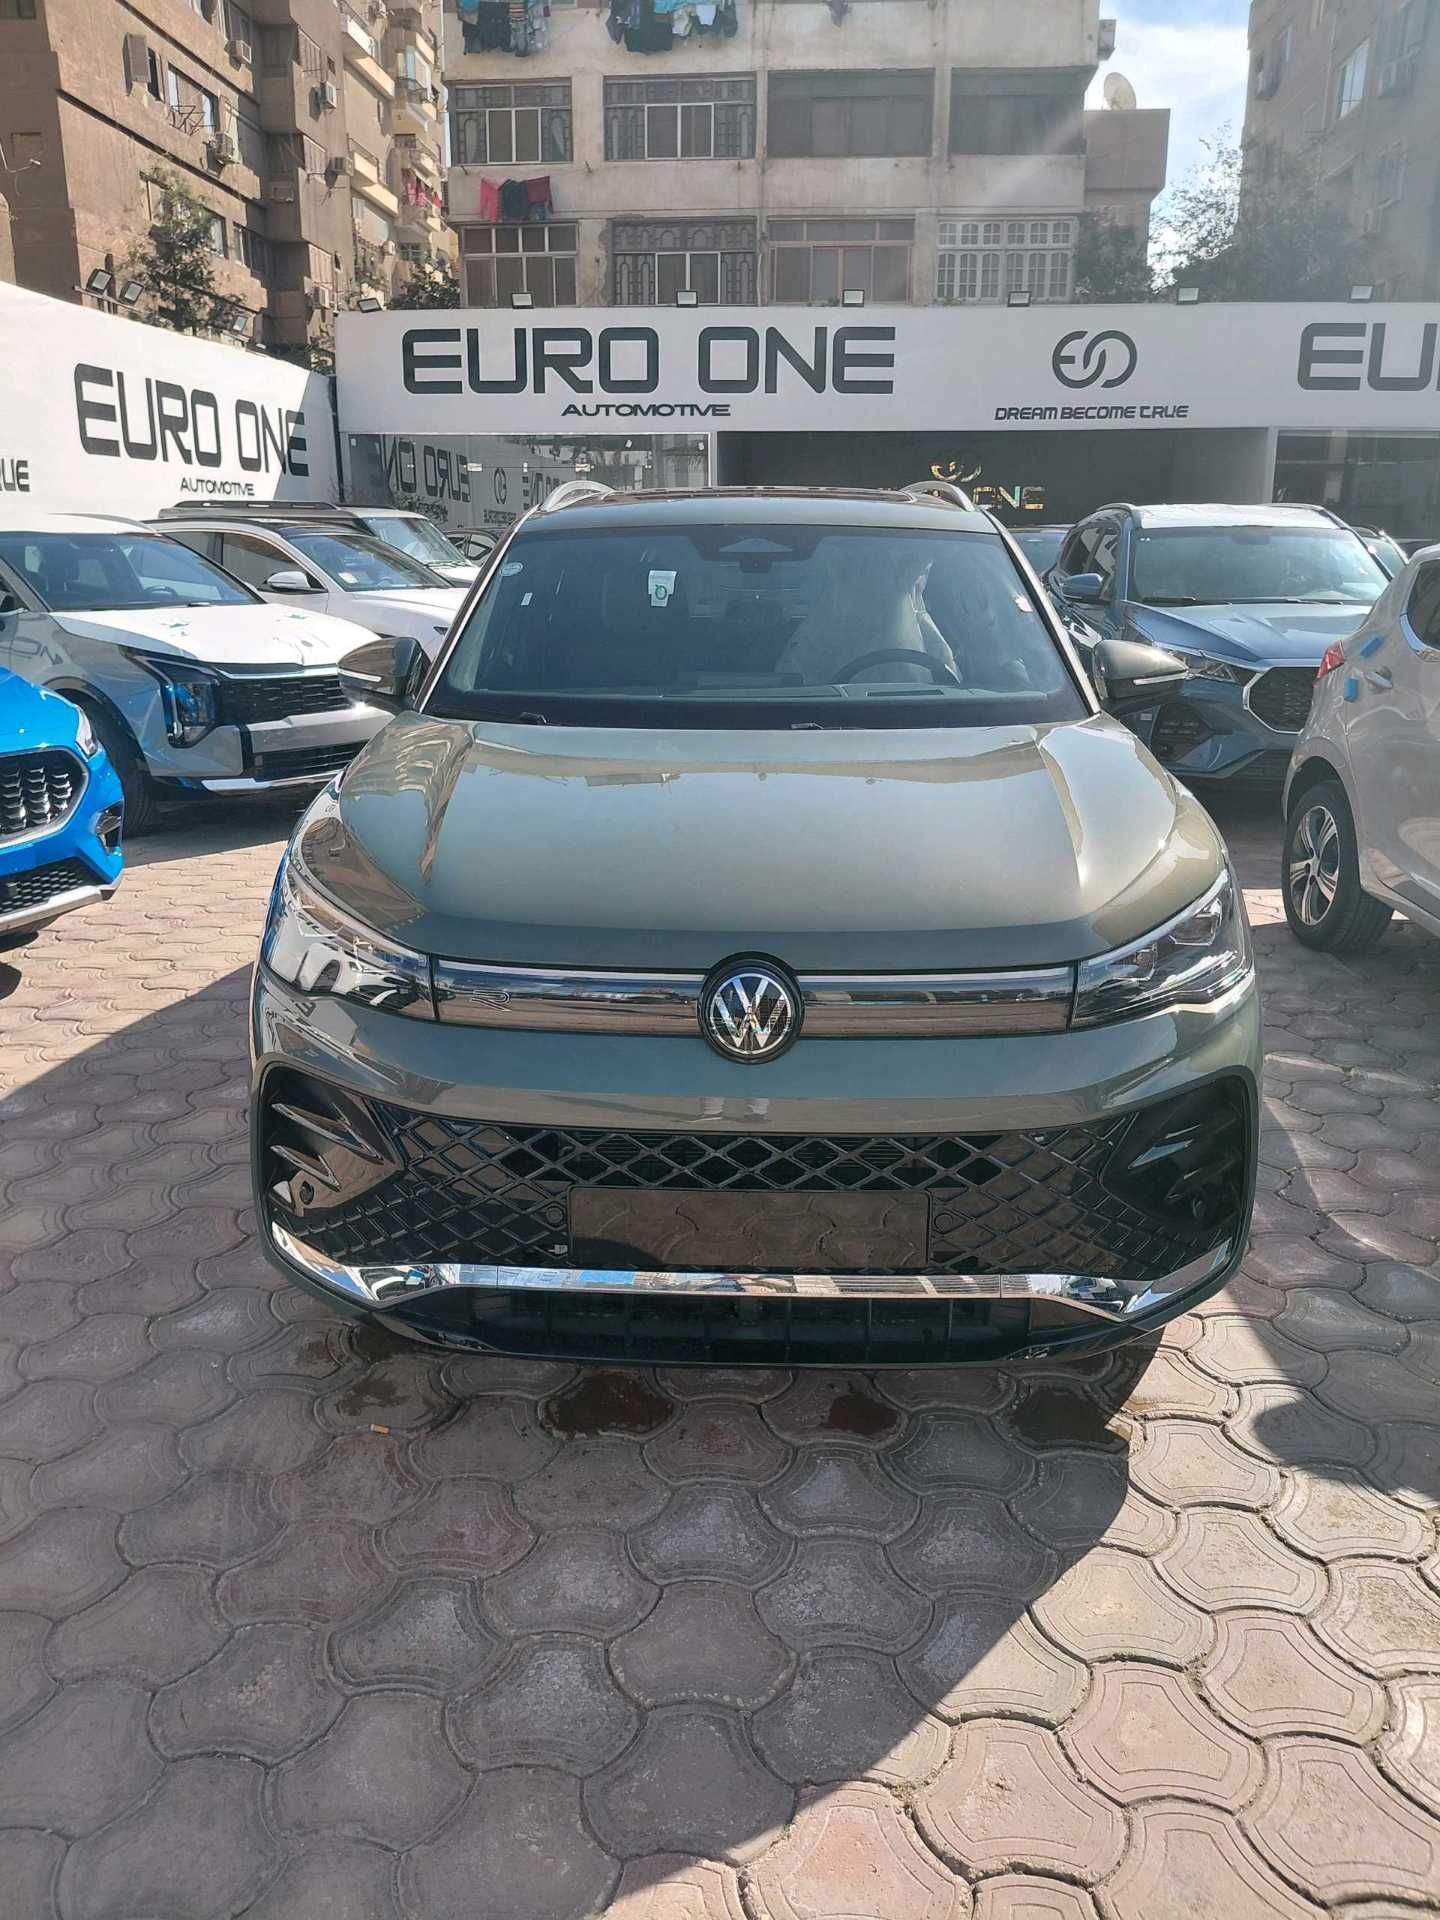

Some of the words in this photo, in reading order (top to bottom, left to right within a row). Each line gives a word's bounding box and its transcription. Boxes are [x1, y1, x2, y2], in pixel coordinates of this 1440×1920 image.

[402, 326, 660, 395] EURO
[698, 326, 896, 395] ONE
[1297, 322, 1440, 392] EU
[74, 362, 222, 469] EURO
[235, 398, 310, 478] ONE
[560, 403, 731, 418] AUTOMOTIVE
[994, 406, 1058, 421] DREAM
[1060, 405, 1137, 420] BECOME
[1139, 404, 1190, 419] TRUE
[0, 458, 30, 493] UE
[179, 477, 256, 497] AUTOMOTIVE
